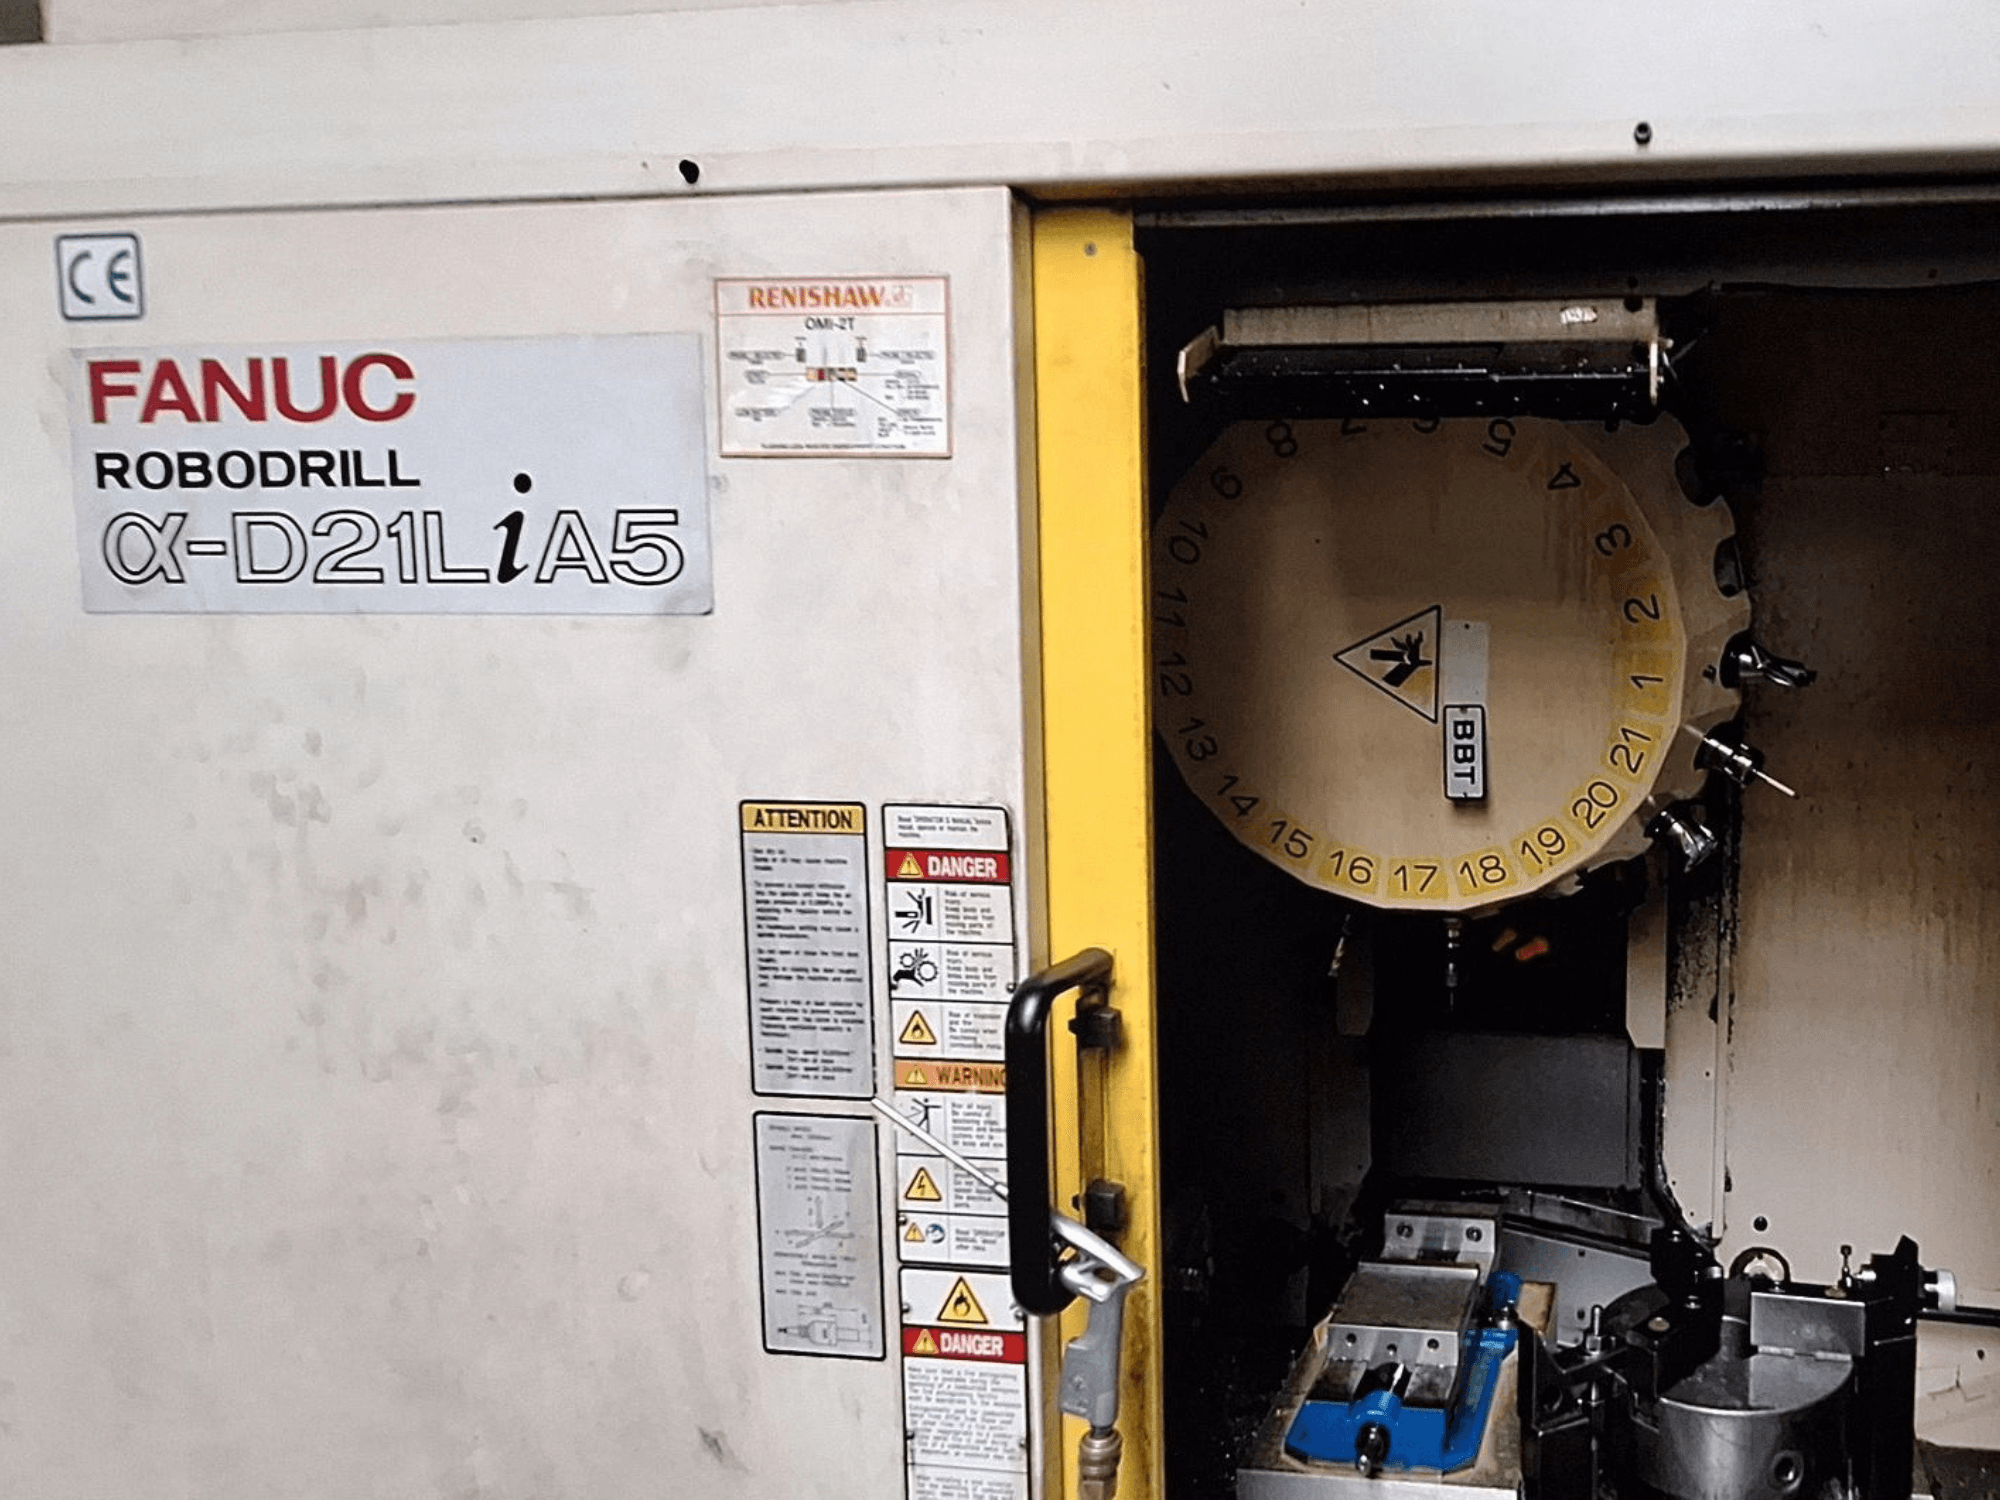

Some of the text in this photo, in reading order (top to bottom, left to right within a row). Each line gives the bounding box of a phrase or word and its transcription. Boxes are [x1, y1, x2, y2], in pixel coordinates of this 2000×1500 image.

[749, 286, 886, 308] RENISHAW
[88, 352, 417, 424] FANUC
[1482, 417, 1517, 457] 5
[95, 449, 421, 489] ROBODRILL
[1210, 465, 1244, 500] 9
[1547, 462, 1582, 491] 4
[1168, 520, 1209, 565] 10
[1596, 523, 1632, 557] 3
[1623, 593, 1661, 624] 2
[1158, 651, 1193, 698] 12
[1630, 671, 1664, 689] 1
[1178, 716, 1218, 762] 13
[1452, 719, 1476, 785] BBT
[1609, 727, 1652, 774] 21
[1216, 774, 1260, 818] 14
[1571, 780, 1619, 829] 20
[753, 808, 853, 829] ATTENTION
[1268, 820, 1314, 859] 15
[1520, 826, 1567, 866] 19
[926, 855, 999, 878] DANGER
[1329, 849, 1375, 885] 16
[1393, 864, 1439, 893] 17
[1459, 855, 1507, 889] 18
[939, 1331, 1004, 1357] DANGER
